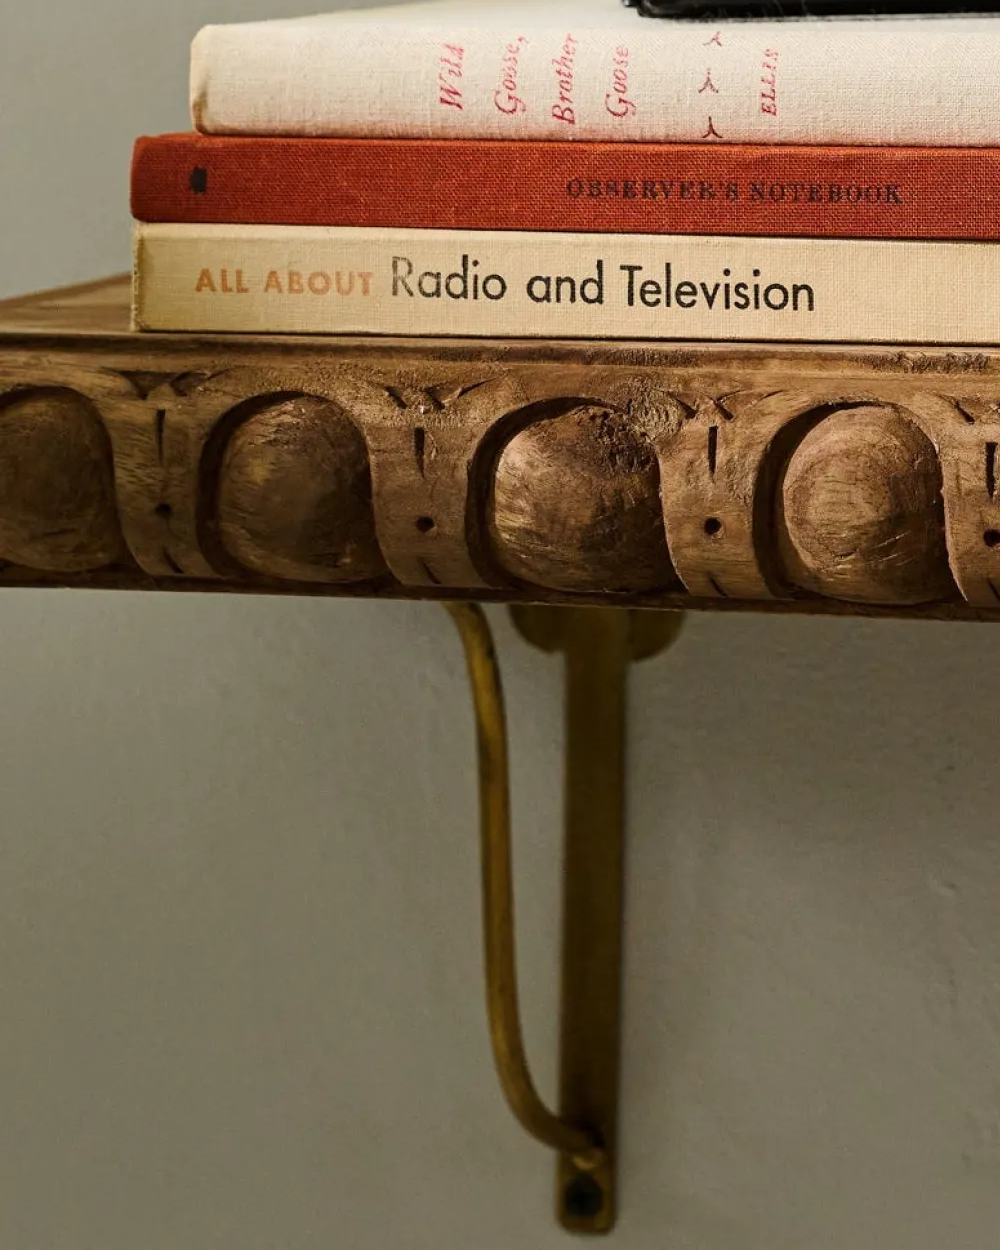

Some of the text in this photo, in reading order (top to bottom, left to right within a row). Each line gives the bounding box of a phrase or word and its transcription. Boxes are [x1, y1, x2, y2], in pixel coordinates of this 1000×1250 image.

[438, 43, 464, 111] Wild
[552, 33, 580, 125] Brother
[605, 45, 635, 119] Goose
[761, 48, 781, 116] ELLIS
[566, 178, 903, 205] OBSERVER'S NOTEBOOK
[195, 255, 815, 312] ALL ABOUT Radio and Television
